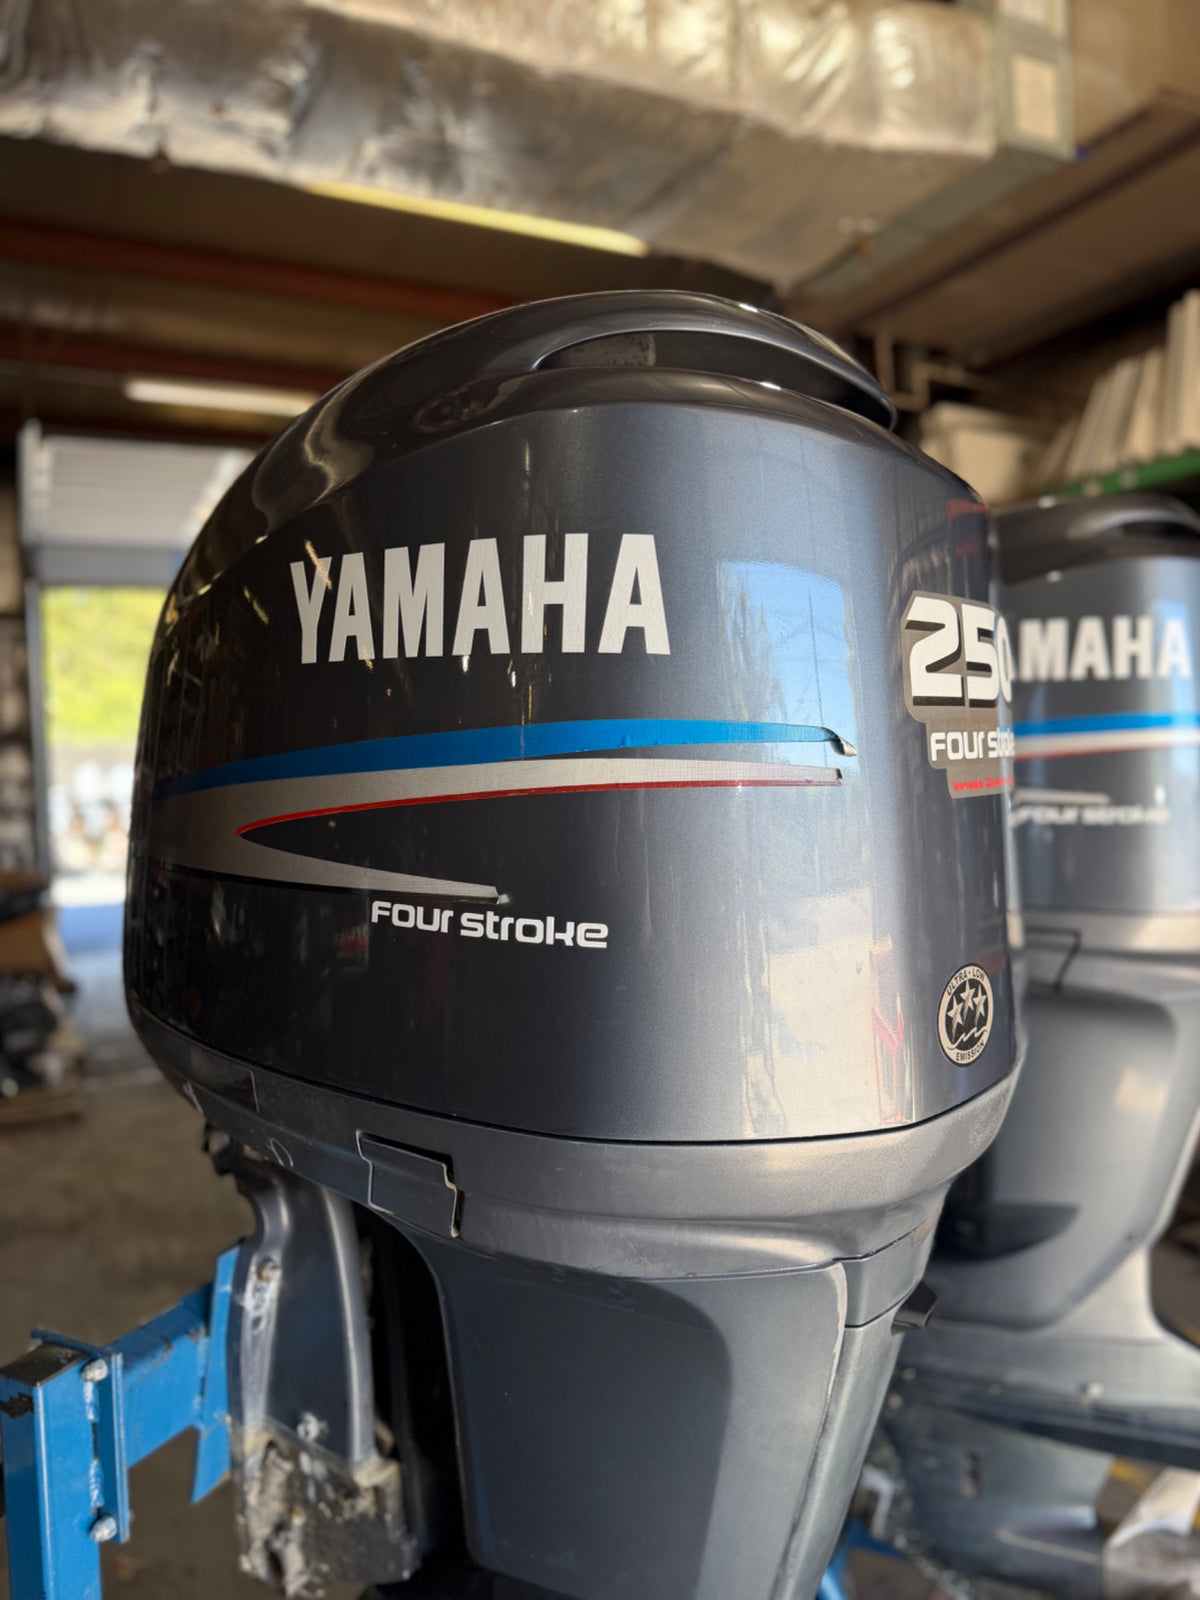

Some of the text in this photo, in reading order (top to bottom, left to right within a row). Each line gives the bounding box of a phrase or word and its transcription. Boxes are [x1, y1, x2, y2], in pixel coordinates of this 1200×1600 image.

[290, 533, 670, 664] YAMAHA
[905, 596, 1012, 706] 250
[1010, 615, 1192, 682] MAHA
[946, 970, 968, 996] ULTRA
[955, 1041, 985, 1062] EMISSION
